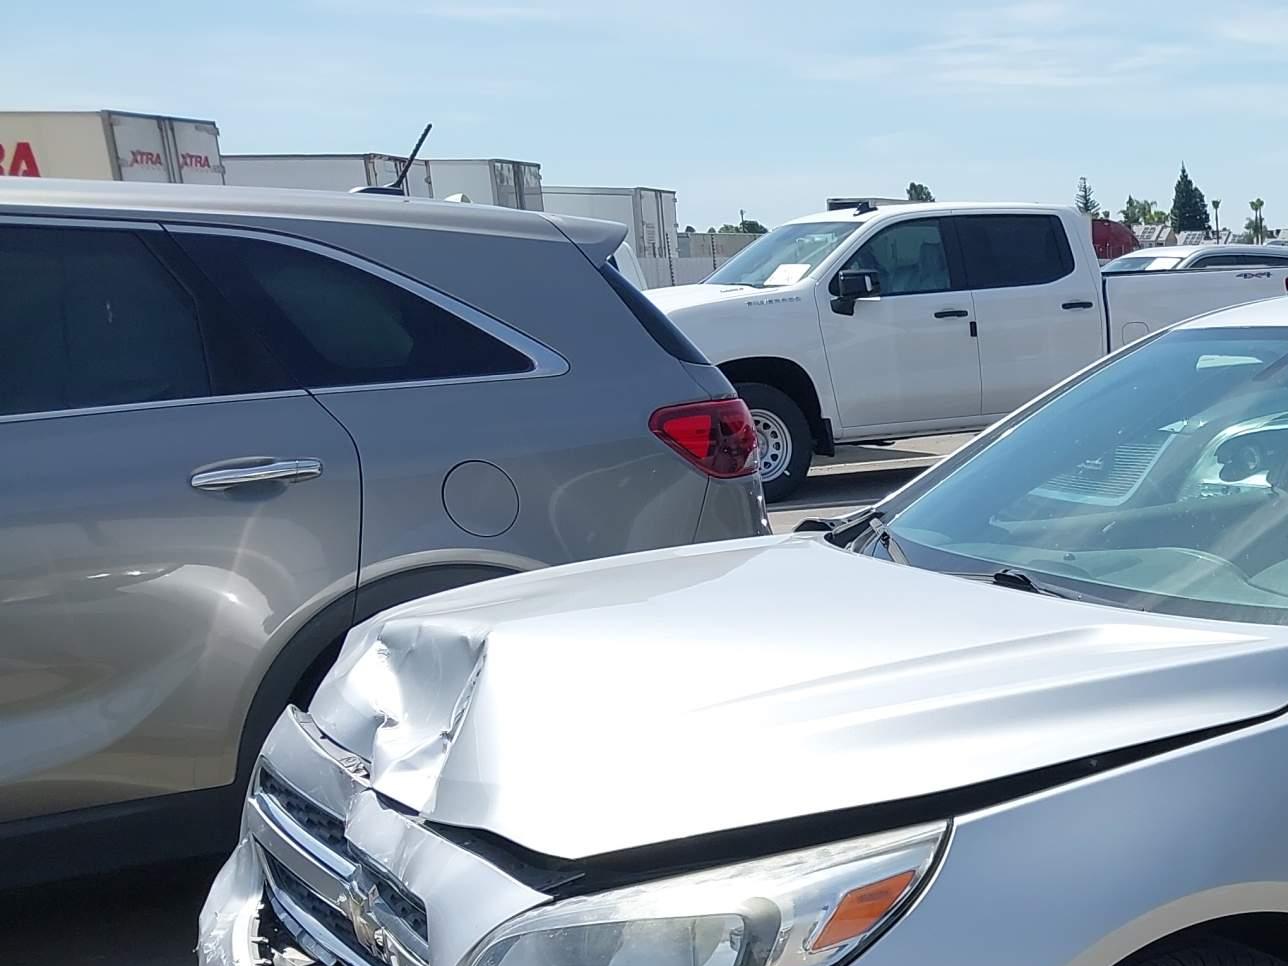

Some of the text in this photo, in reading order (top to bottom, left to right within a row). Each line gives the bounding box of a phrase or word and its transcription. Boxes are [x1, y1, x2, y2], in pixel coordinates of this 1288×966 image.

[0, 142, 41, 177] A
[130, 150, 163, 167] XTRA
[181, 153, 211, 169] XTRA
